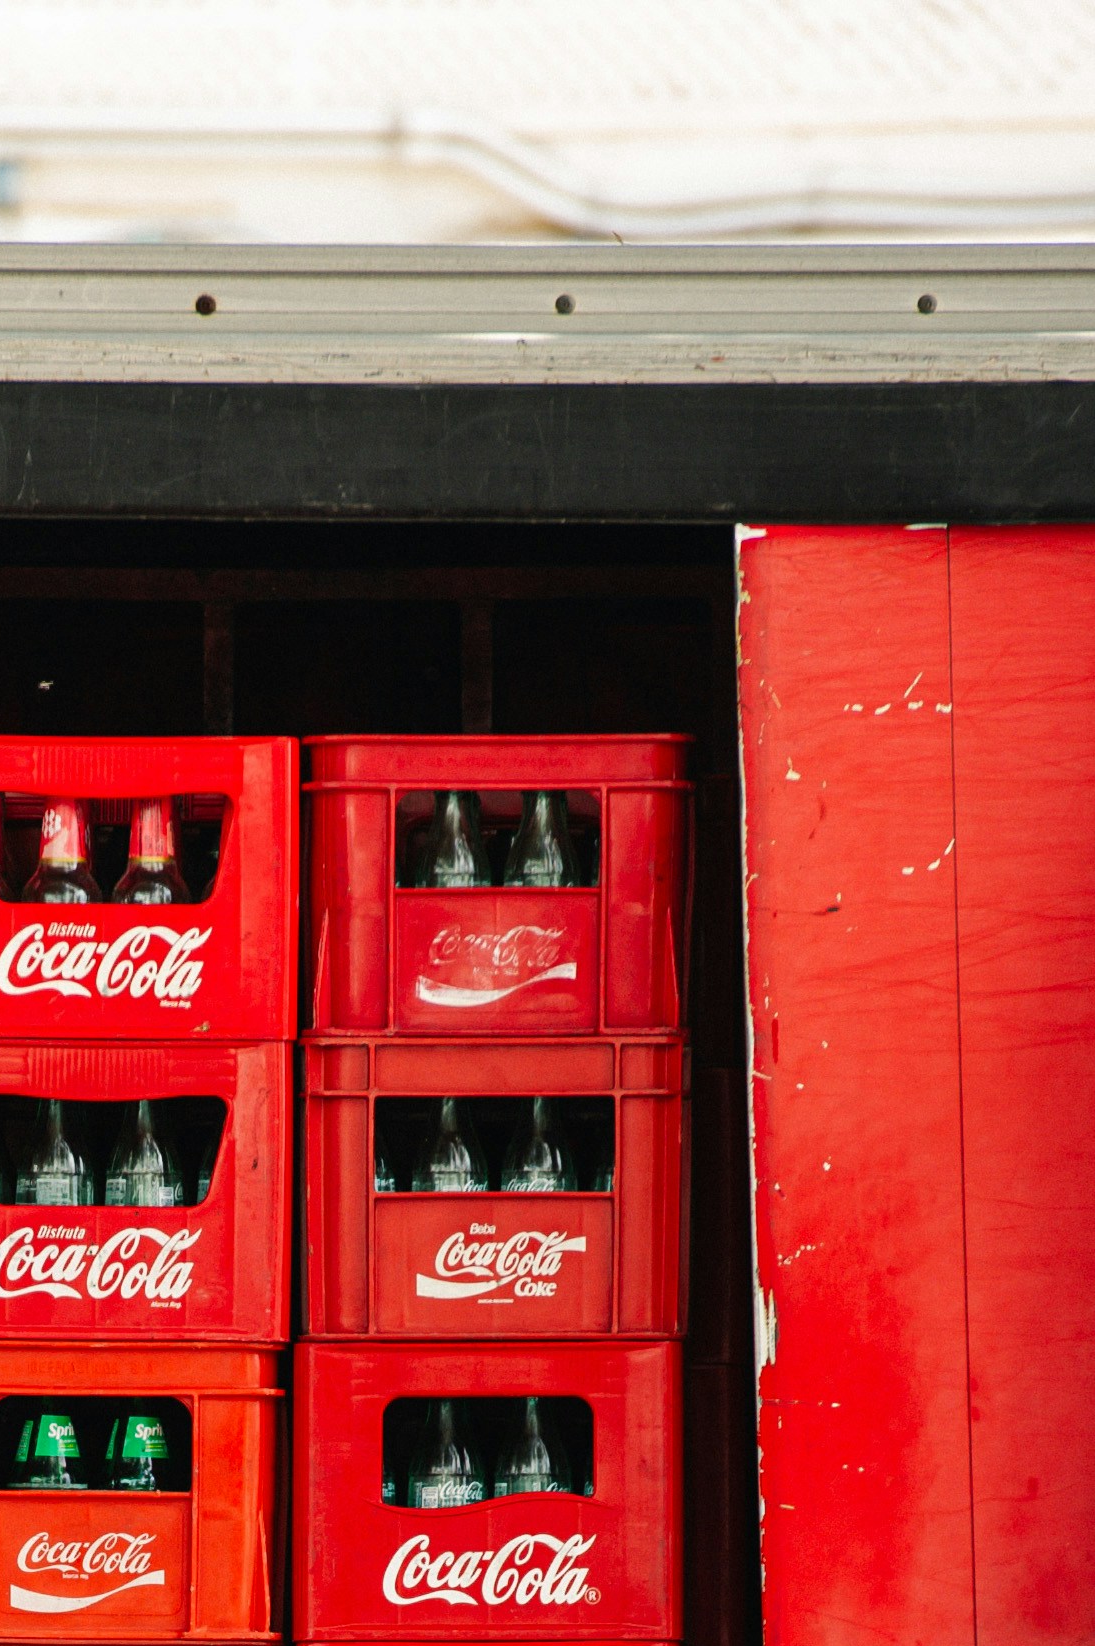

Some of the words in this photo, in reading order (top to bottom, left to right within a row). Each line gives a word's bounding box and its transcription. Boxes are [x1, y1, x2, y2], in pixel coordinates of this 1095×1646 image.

[48, 922, 96, 938] Disfruta
[429, 925, 567, 968] Coca-Cola
[37, 1225, 85, 1240] Disfruta
[470, 1223, 496, 1236] Beba
[435, 1231, 567, 1278] Coca-Cola
[514, 1278, 557, 1297] Coke
[17, 1532, 157, 1574] Coca-Cola
